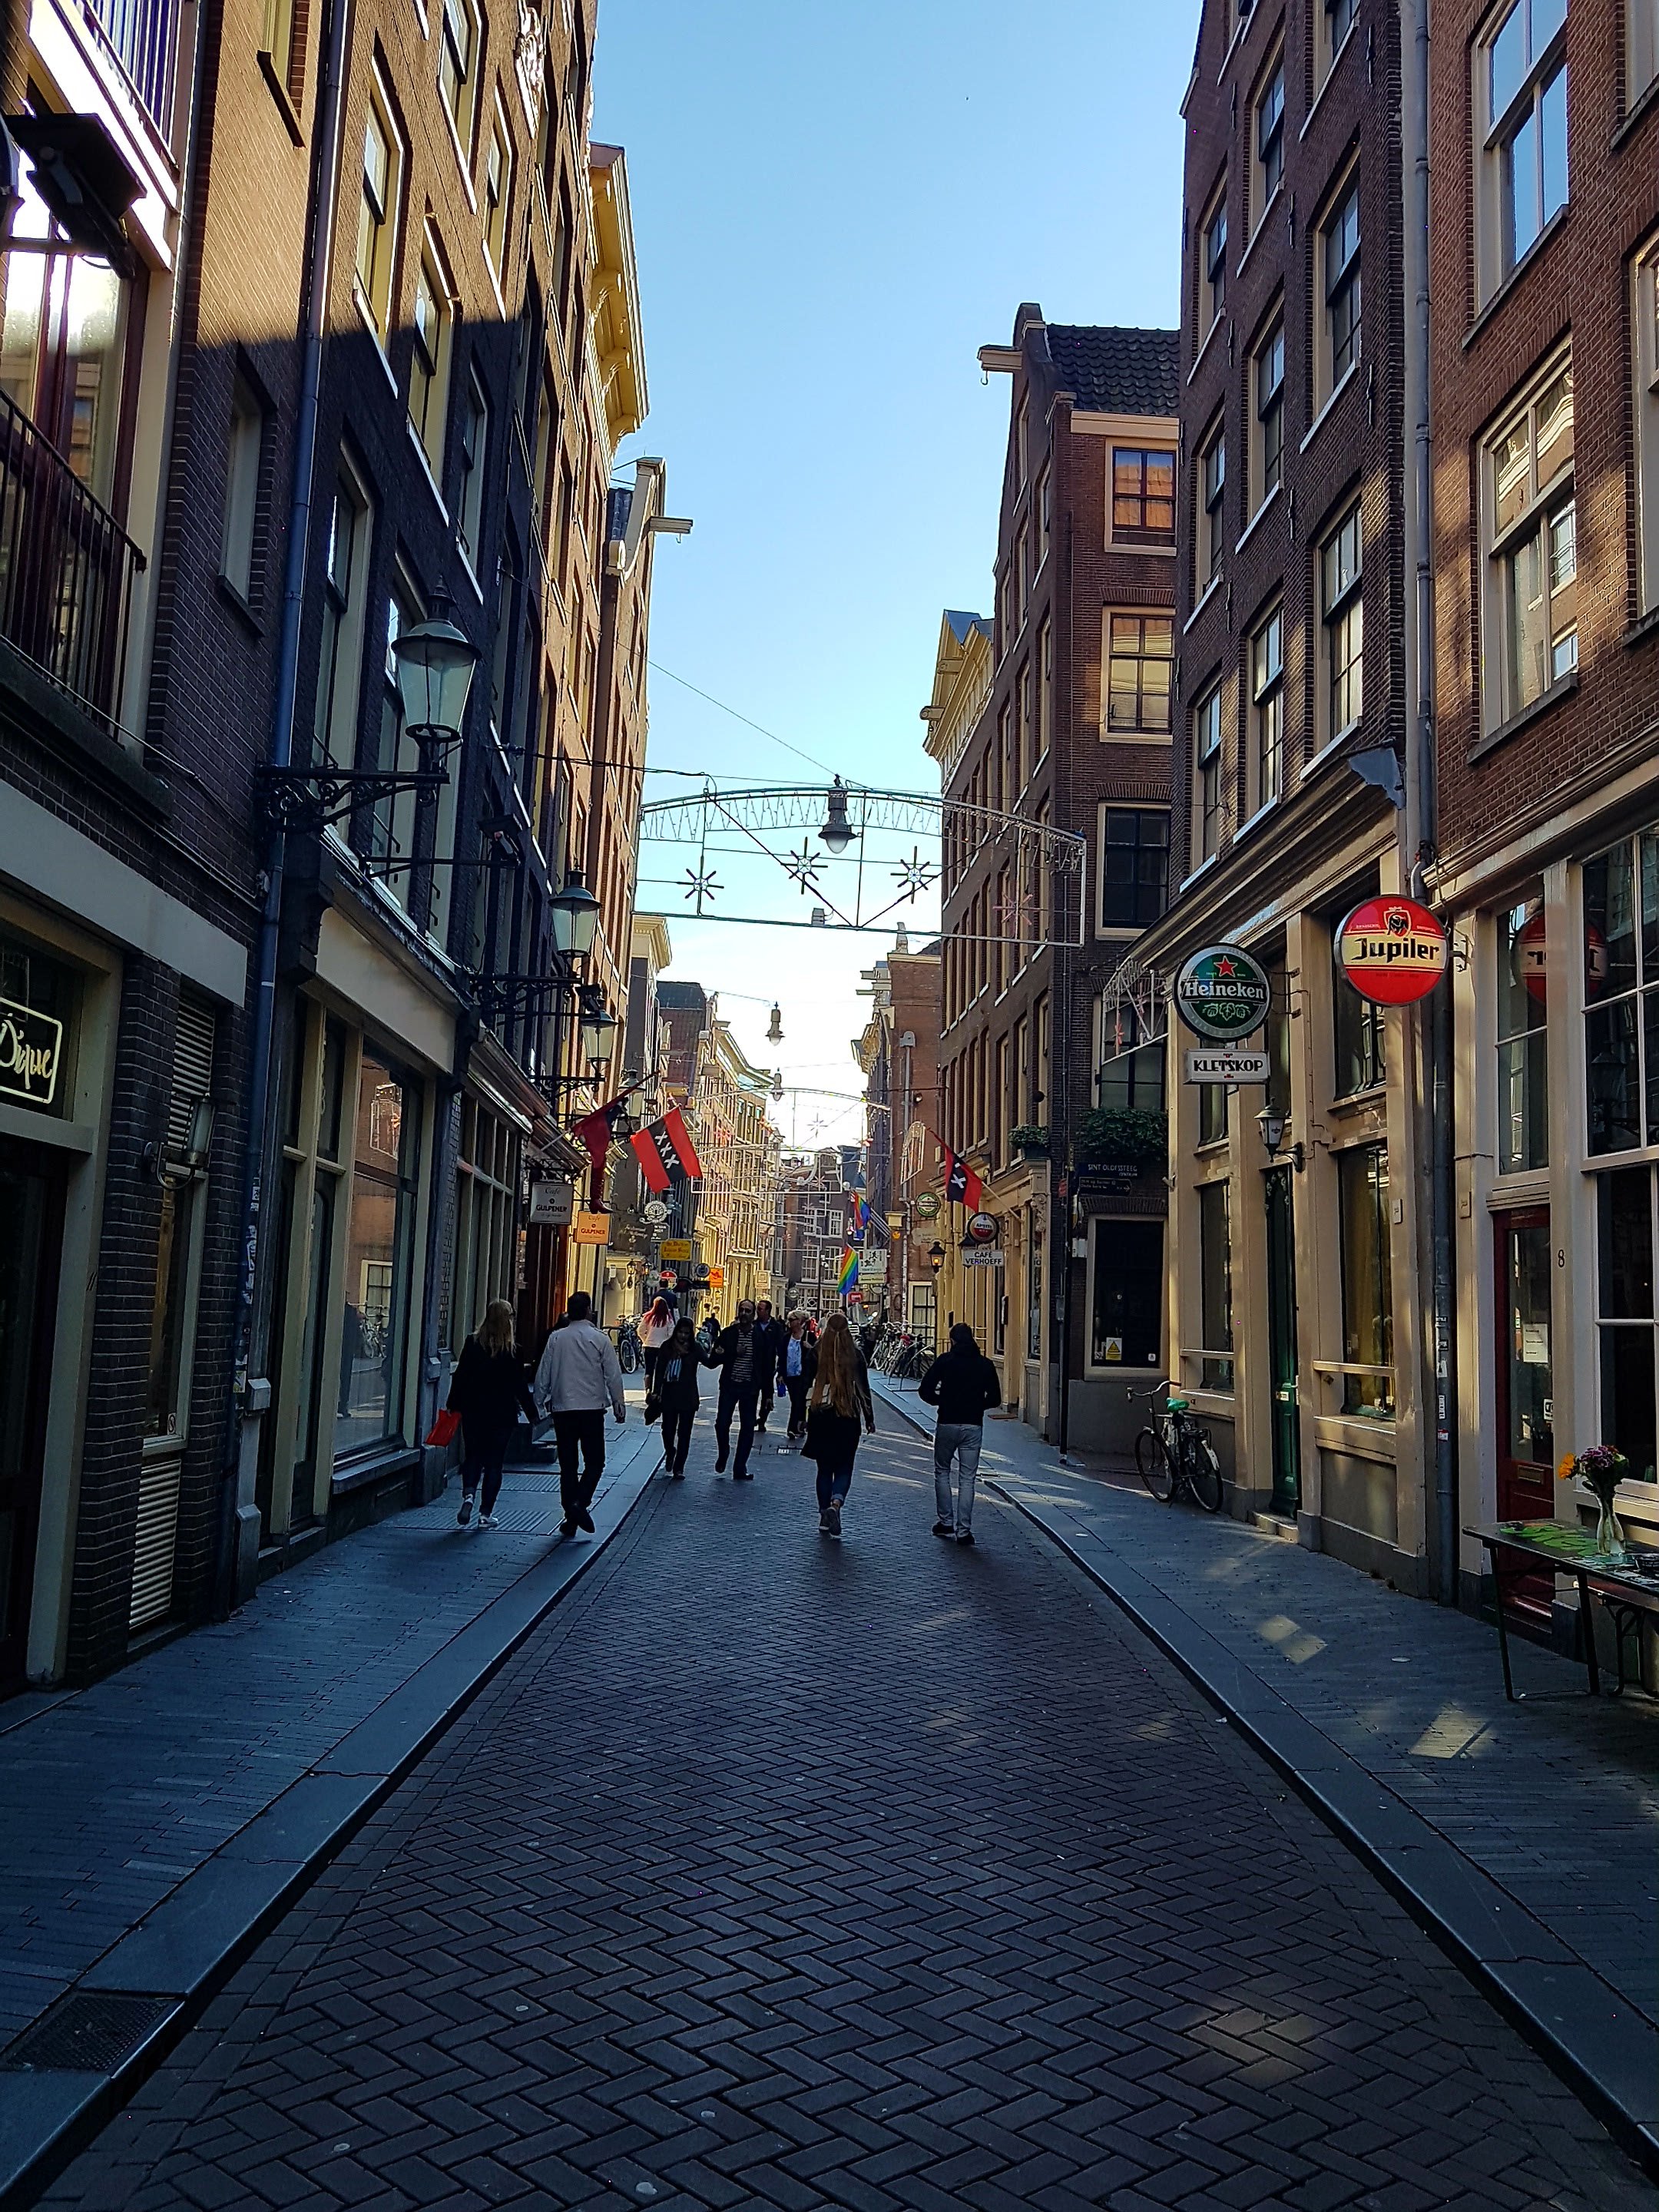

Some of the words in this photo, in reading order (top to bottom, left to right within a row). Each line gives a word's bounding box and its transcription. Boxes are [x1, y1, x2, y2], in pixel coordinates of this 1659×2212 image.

[1351, 937, 1440, 963] Jupiler
[1184, 982, 1264, 998] Heineken
[1194, 1059, 1263, 1072] KLETSKOP
[1558, 1249, 1565, 1268] 8
